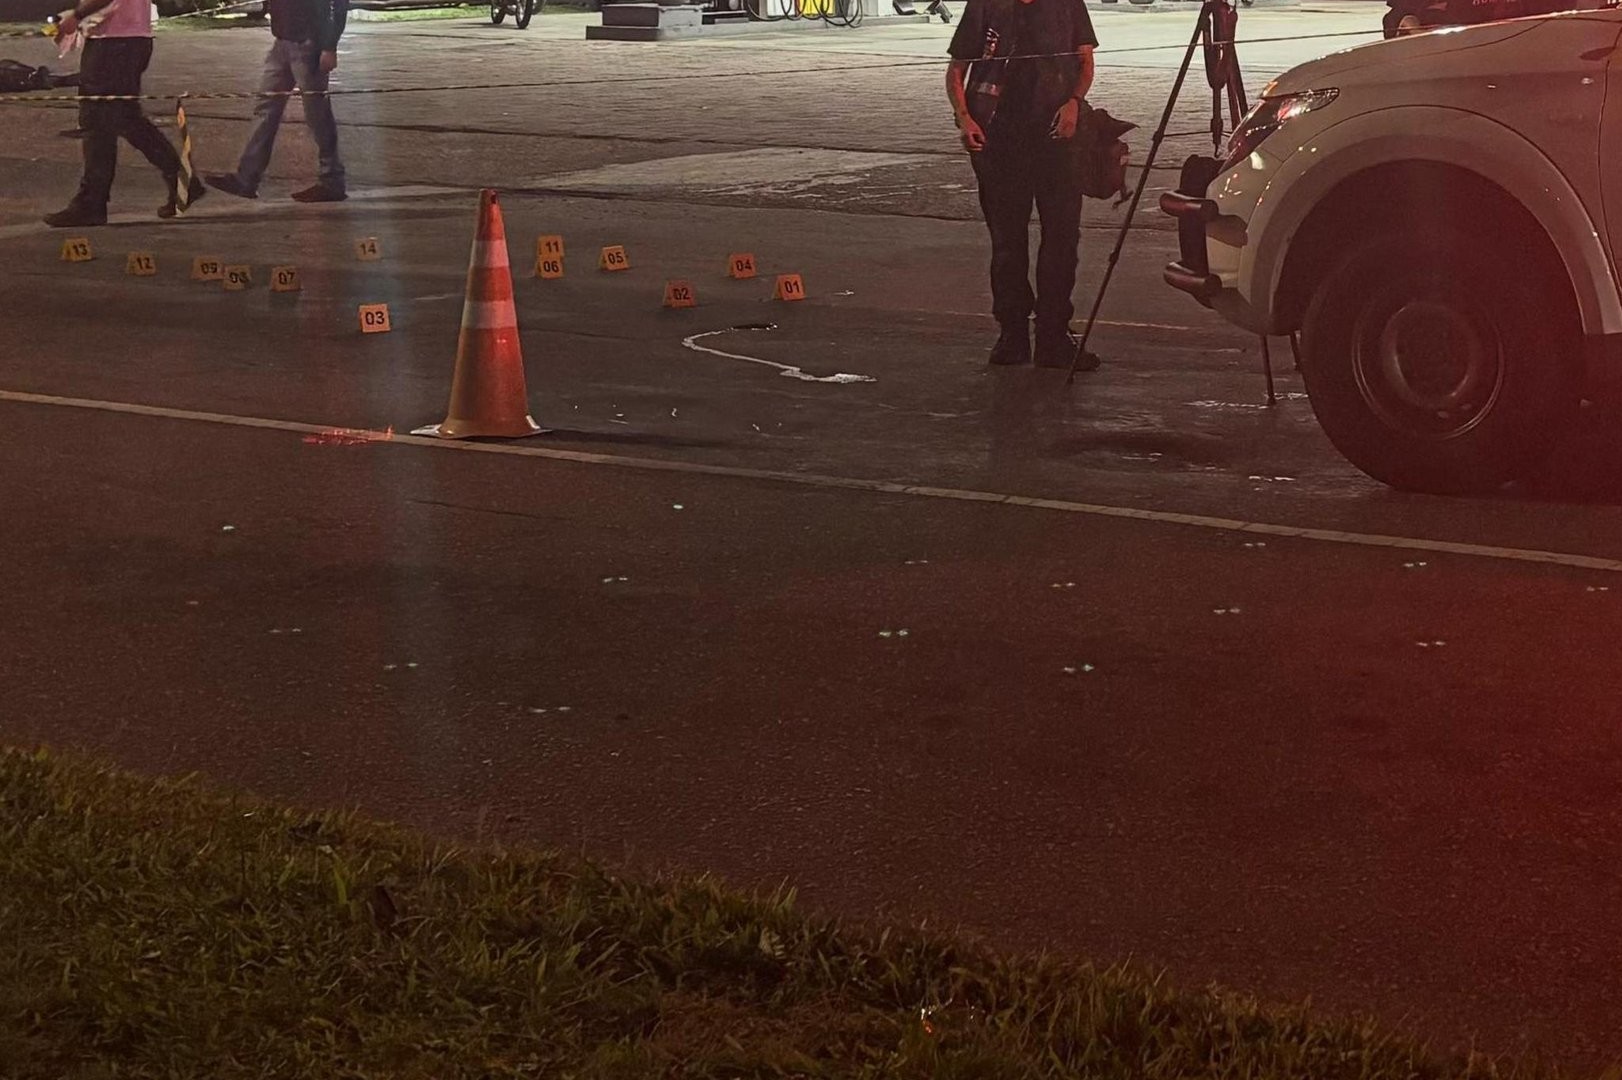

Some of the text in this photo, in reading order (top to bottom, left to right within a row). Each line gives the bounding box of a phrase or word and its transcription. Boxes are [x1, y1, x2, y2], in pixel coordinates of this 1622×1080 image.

[73, 244, 88, 256] 13
[360, 243, 376, 255] 14
[545, 241, 560, 253] 11
[136, 257, 150, 269] 12
[607, 251, 624, 265] 05
[201, 262, 217, 274] 09
[543, 260, 559, 273] 06
[736, 260, 752, 271] 04
[279, 272, 294, 285] 07
[784, 280, 800, 294] 01
[673, 287, 690, 300] 02
[365, 312, 385, 325] 03
